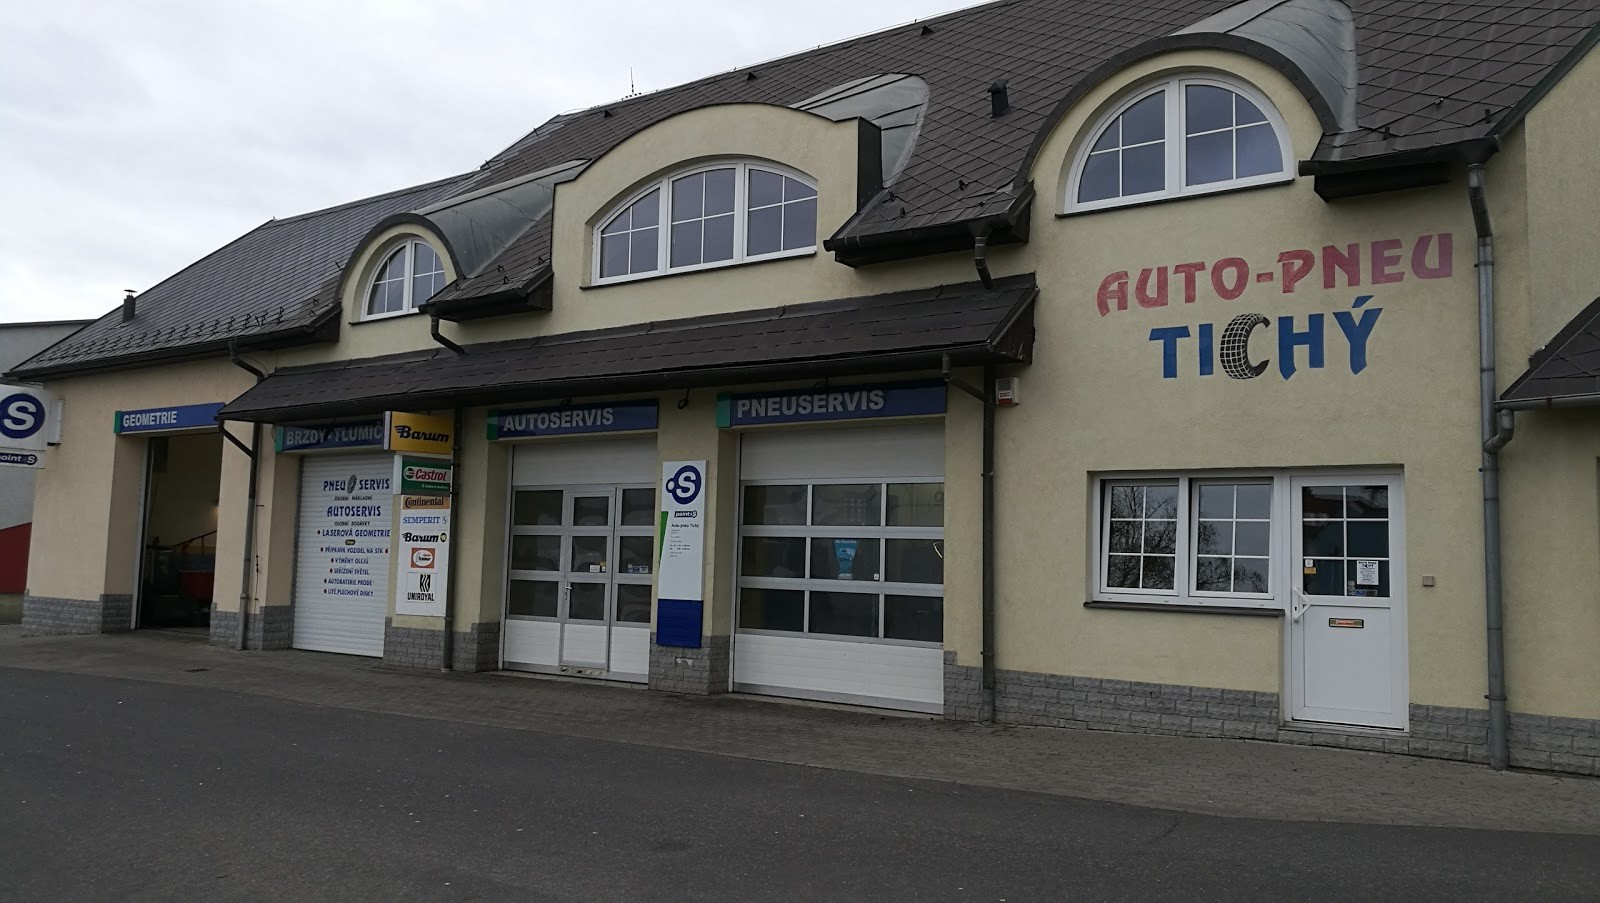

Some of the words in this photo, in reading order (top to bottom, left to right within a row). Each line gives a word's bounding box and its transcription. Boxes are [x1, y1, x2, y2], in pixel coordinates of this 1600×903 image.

[1096, 232, 1454, 318] AUTO-PNEU
[1148, 294, 1384, 381] TICHÝ
[737, 389, 885, 418] PNEUSERVIS
[122, 410, 178, 428] GEOMETRIE
[503, 407, 614, 432] AUTOSERVIS
[286, 428, 327, 446] BRZDY
[394, 425, 450, 443] Barum
[0, 454, 23, 462] oint
[415, 468, 448, 482] Castrol
[323, 480, 346, 492] PNEU
[359, 478, 390, 491] SERVIS
[404, 496, 444, 508] Continental
[327, 505, 382, 517] AUTOSERVIS
[403, 516, 441, 525] SEMPERIT
[322, 528, 353, 537] LASEROVÁ
[354, 529, 391, 537] GEOMETRIE
[401, 532, 440, 543] Barum
[328, 578, 357, 586] AUTOBATERIE
[407, 591, 435, 602] UNIROYAL
